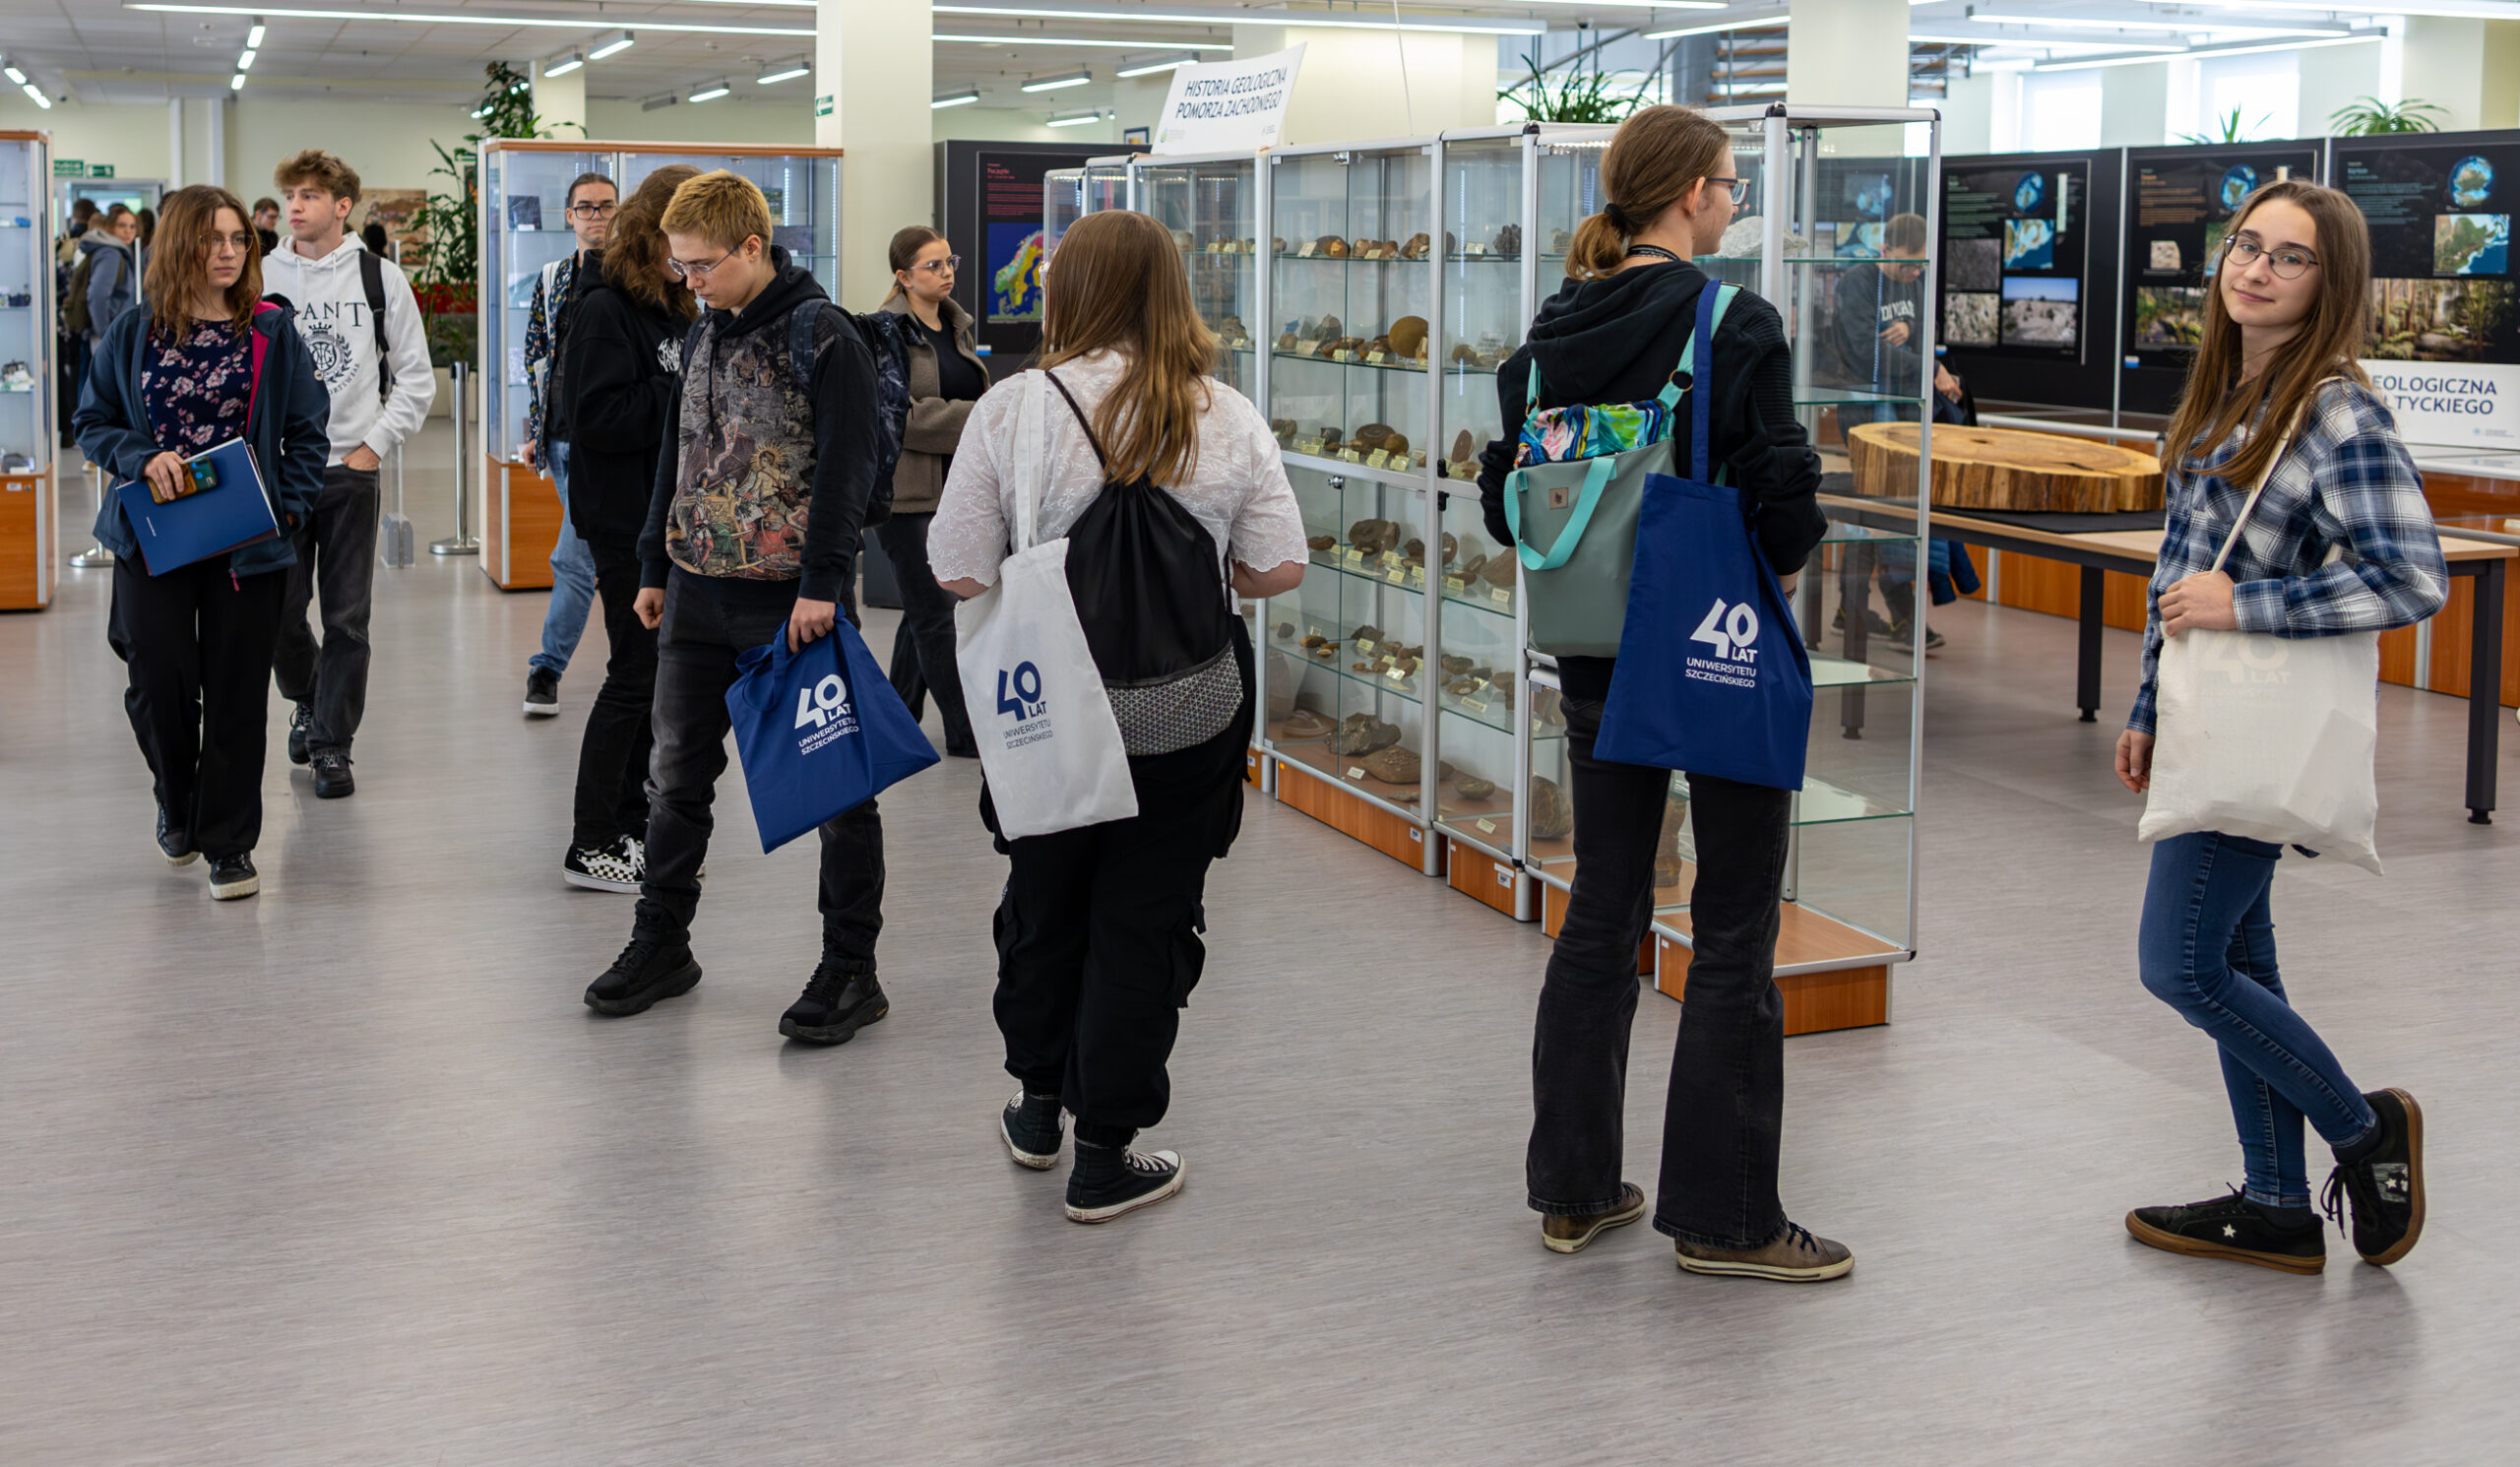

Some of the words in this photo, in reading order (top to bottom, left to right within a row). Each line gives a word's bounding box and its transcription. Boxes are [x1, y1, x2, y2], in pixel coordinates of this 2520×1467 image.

[1184, 79, 1230, 97] HISTORIA
[1231, 66, 1288, 95] GEOLOGICZNA
[1175, 100, 1224, 119] POMORZA
[1224, 90, 1283, 117] ZACHODNIEGO
[301, 301, 367, 328] ANT
[329, 362, 361, 395] ORTSWEAR
[2372, 375, 2497, 396] EOLOGICZNA
[1689, 597, 1759, 659] 40
[1686, 657, 1757, 677] UNIWERSYTETU
[1732, 646, 1758, 664] LAT
[1685, 669, 1755, 688] SZCZECIŃSKIEGO
[2250, 670, 2292, 684] LAT
[794, 673, 847, 730] 40
[997, 661, 1041, 722] 40
[828, 703, 851, 722] LAT
[1028, 700, 1046, 718] LAT
[798, 717, 856, 747] UNIWERSYTETU
[800, 726, 859, 755] SZCZECIŃSKIEGO
[1004, 718, 1051, 739] UNIWERSYTETU
[1006, 730, 1055, 749] SZCZECIŃSKIEGO
